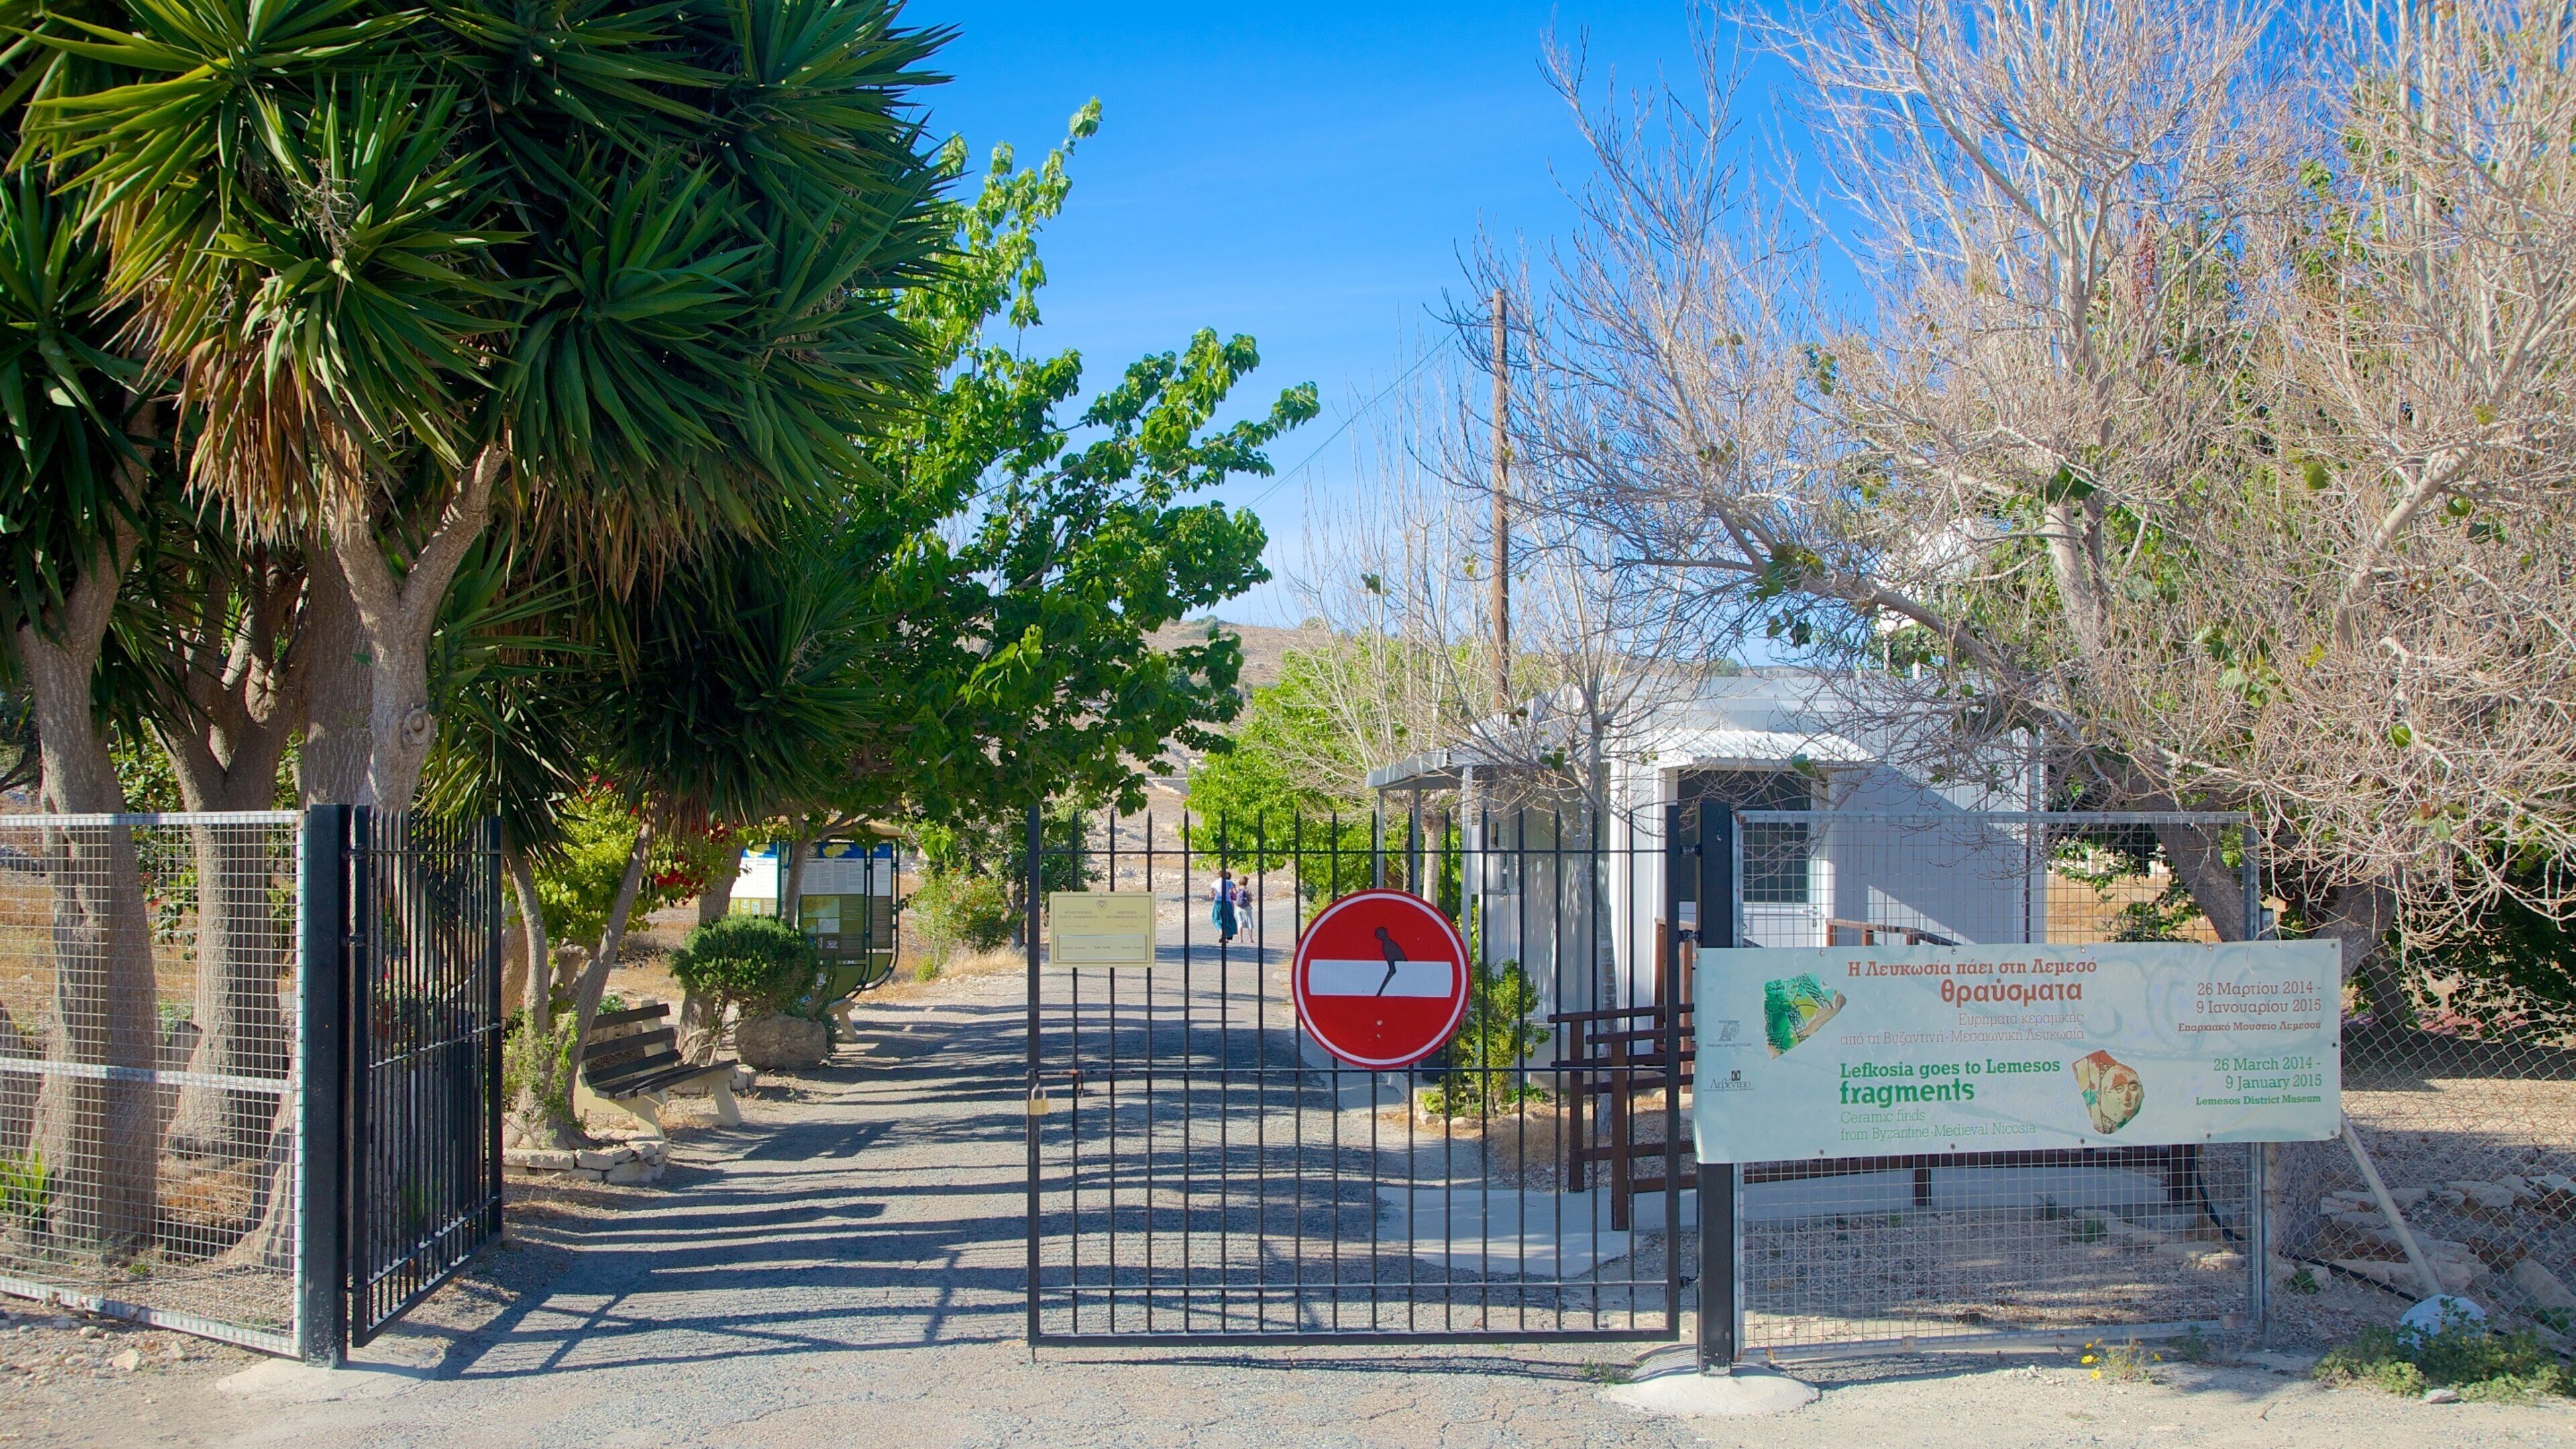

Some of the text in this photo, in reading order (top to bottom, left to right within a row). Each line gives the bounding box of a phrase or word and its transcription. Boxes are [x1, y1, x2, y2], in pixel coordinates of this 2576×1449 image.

[1847, 957, 2097, 977] Η Λευκωσία πάει στη Λεμεσό
[1941, 978, 2083, 1008] θραύσματα
[2197, 982, 2213, 996] 26
[2216, 981, 2279, 998] Μαρτίου
[2282, 980, 2314, 994] 2014
[2196, 998, 2322, 1015] 9 Ιανουαρίου 2015
[1958, 1011, 2084, 1028] Ευρήματα κεραμικής
[2178, 1020, 2322, 1033] Επαρχιακό Μουσείο Λεμεσού
[1840, 1032, 1864, 1045] από
[1867, 1034, 1880, 1044] τη
[2026, 1026, 2085, 1040] Λευκωσία
[1839, 1058, 2061, 1079] Lefkosia goes to Lemesos
[2213, 1058, 2229, 1071] 26
[2233, 1057, 2279, 1071] March
[2282, 1056, 2313, 1070] 2014
[2225, 1073, 2322, 1091] 9 January 2015
[1839, 1077, 1975, 1108] fragments
[2195, 1094, 2322, 1106] Lemesos District Museum
[1840, 1108, 1926, 1124] Ceramic finds
[1840, 1128, 1868, 1141] from
[1992, 1121, 2037, 1134] Nicosia
